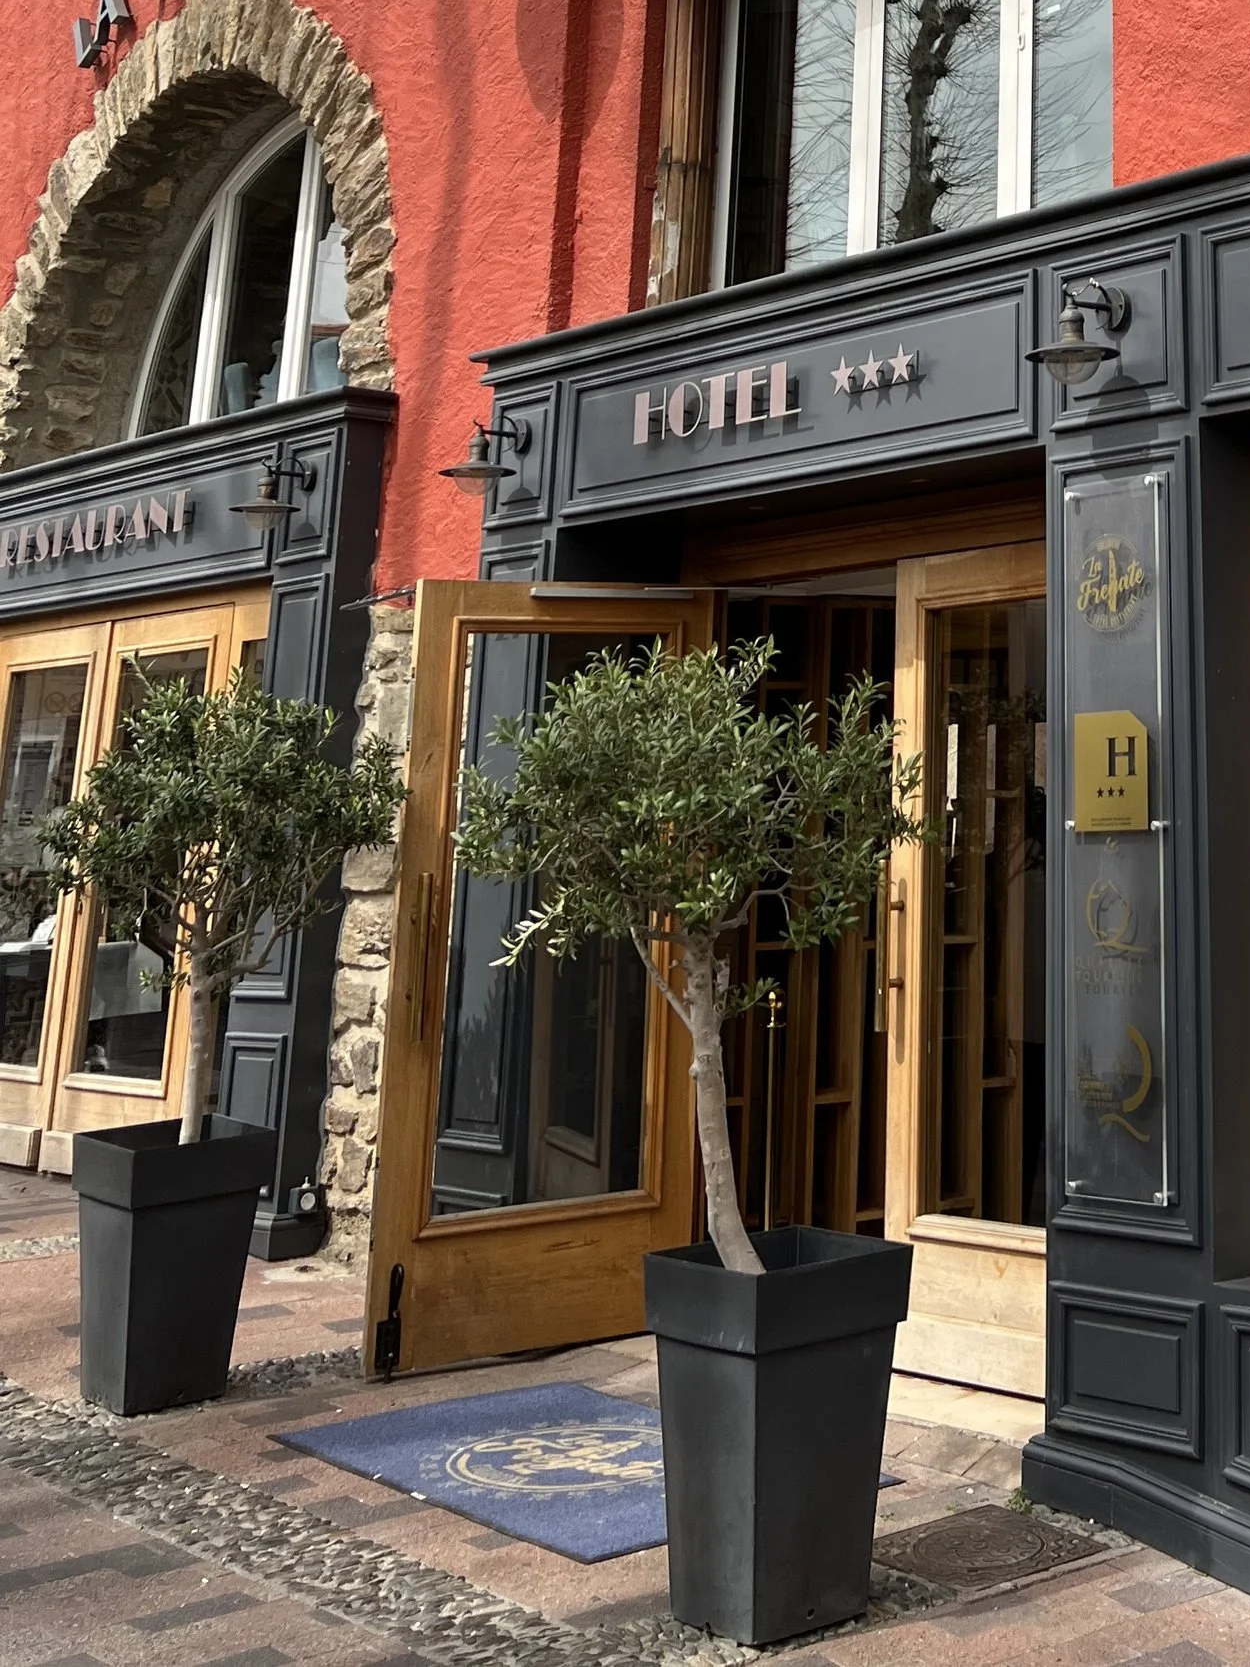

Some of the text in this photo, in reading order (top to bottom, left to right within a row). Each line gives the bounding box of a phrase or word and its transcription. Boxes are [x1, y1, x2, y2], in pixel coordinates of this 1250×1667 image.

[632, 360, 803, 446] HOTEL
[0, 487, 191, 569] RESTAURANT
[1106, 735, 1138, 777] H
